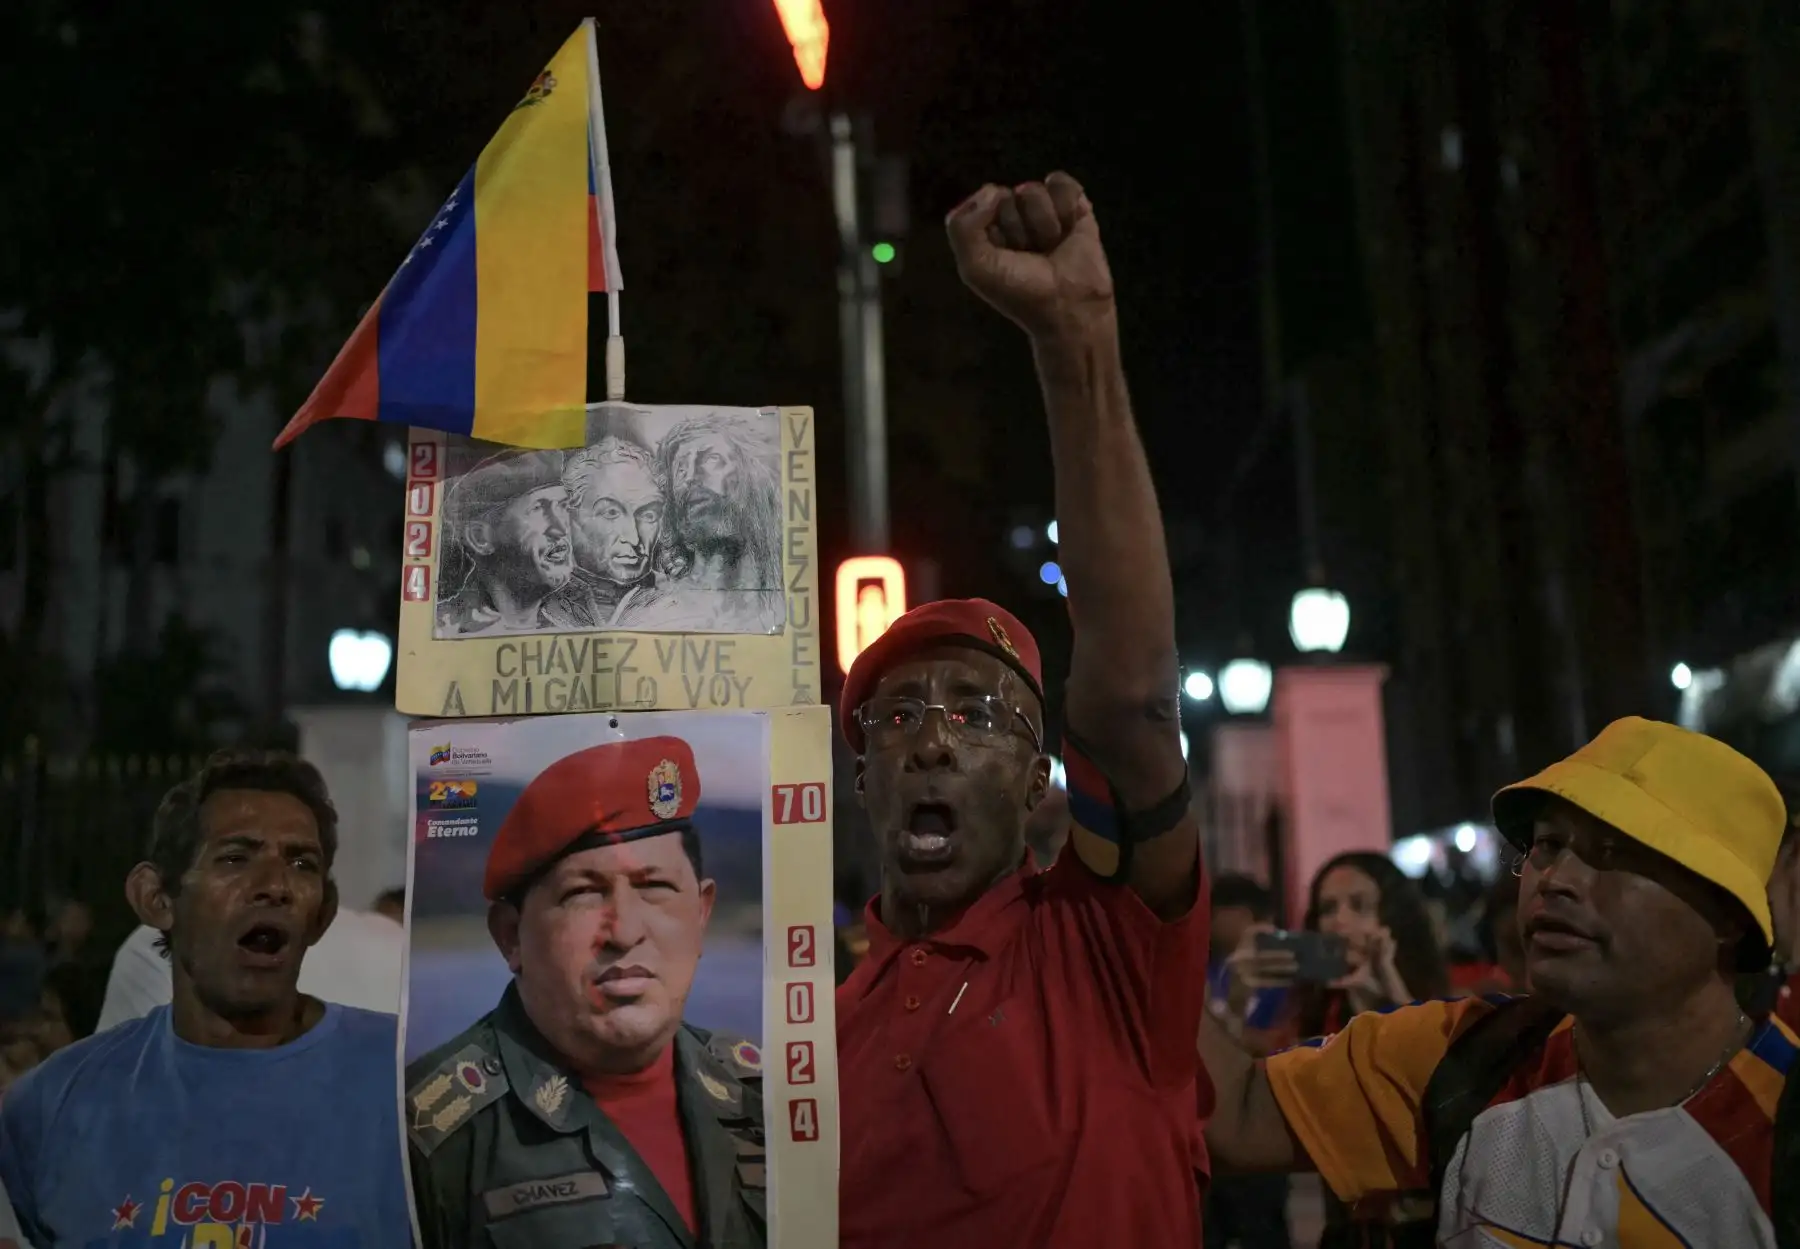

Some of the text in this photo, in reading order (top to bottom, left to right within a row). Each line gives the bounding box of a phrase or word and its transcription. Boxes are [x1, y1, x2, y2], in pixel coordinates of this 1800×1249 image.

[406, 444, 433, 599] 2024
[788, 414, 815, 705] VENEZUELA
[441, 680, 466, 715] A
[544, 673, 658, 711] GALLO
[681, 674, 753, 708] VOY
[427, 818, 478, 826] Comandante
[777, 786, 822, 822] 70
[427, 826, 478, 837] Eterno
[789, 927, 816, 1139] 2024
